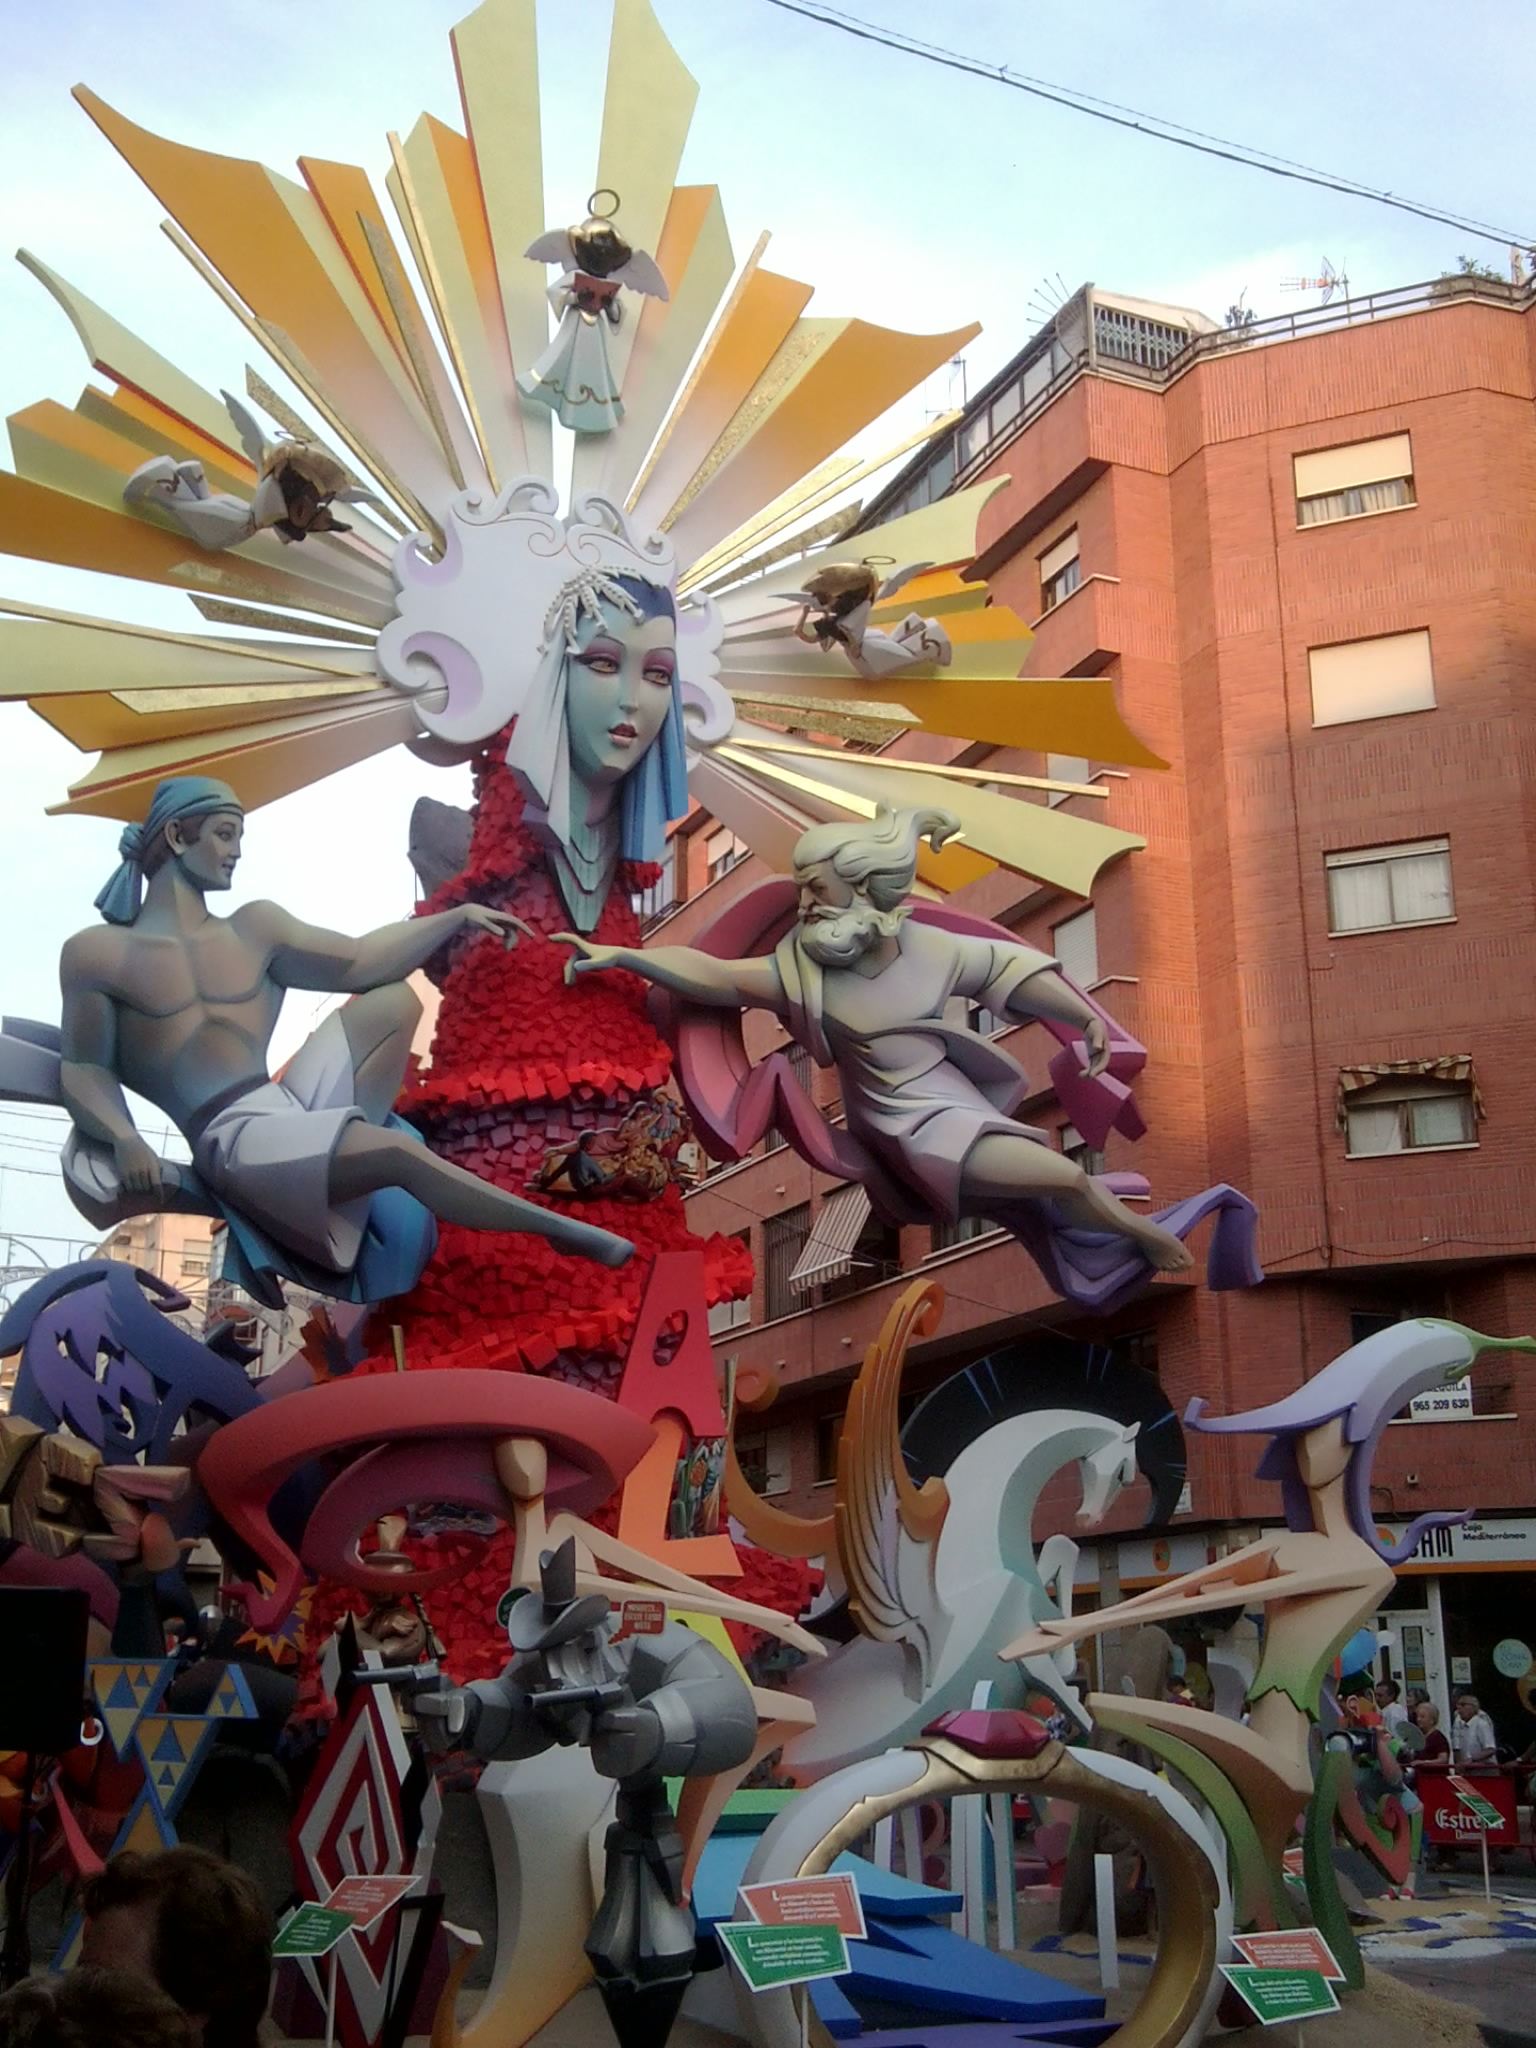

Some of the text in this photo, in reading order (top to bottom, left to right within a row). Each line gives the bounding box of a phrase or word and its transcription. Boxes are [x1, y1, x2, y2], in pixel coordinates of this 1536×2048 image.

[1413, 1399, 1469, 1411] 965 209 630
[1406, 1526, 1454, 1558] AM
[1435, 1807, 1504, 1830] Estre
